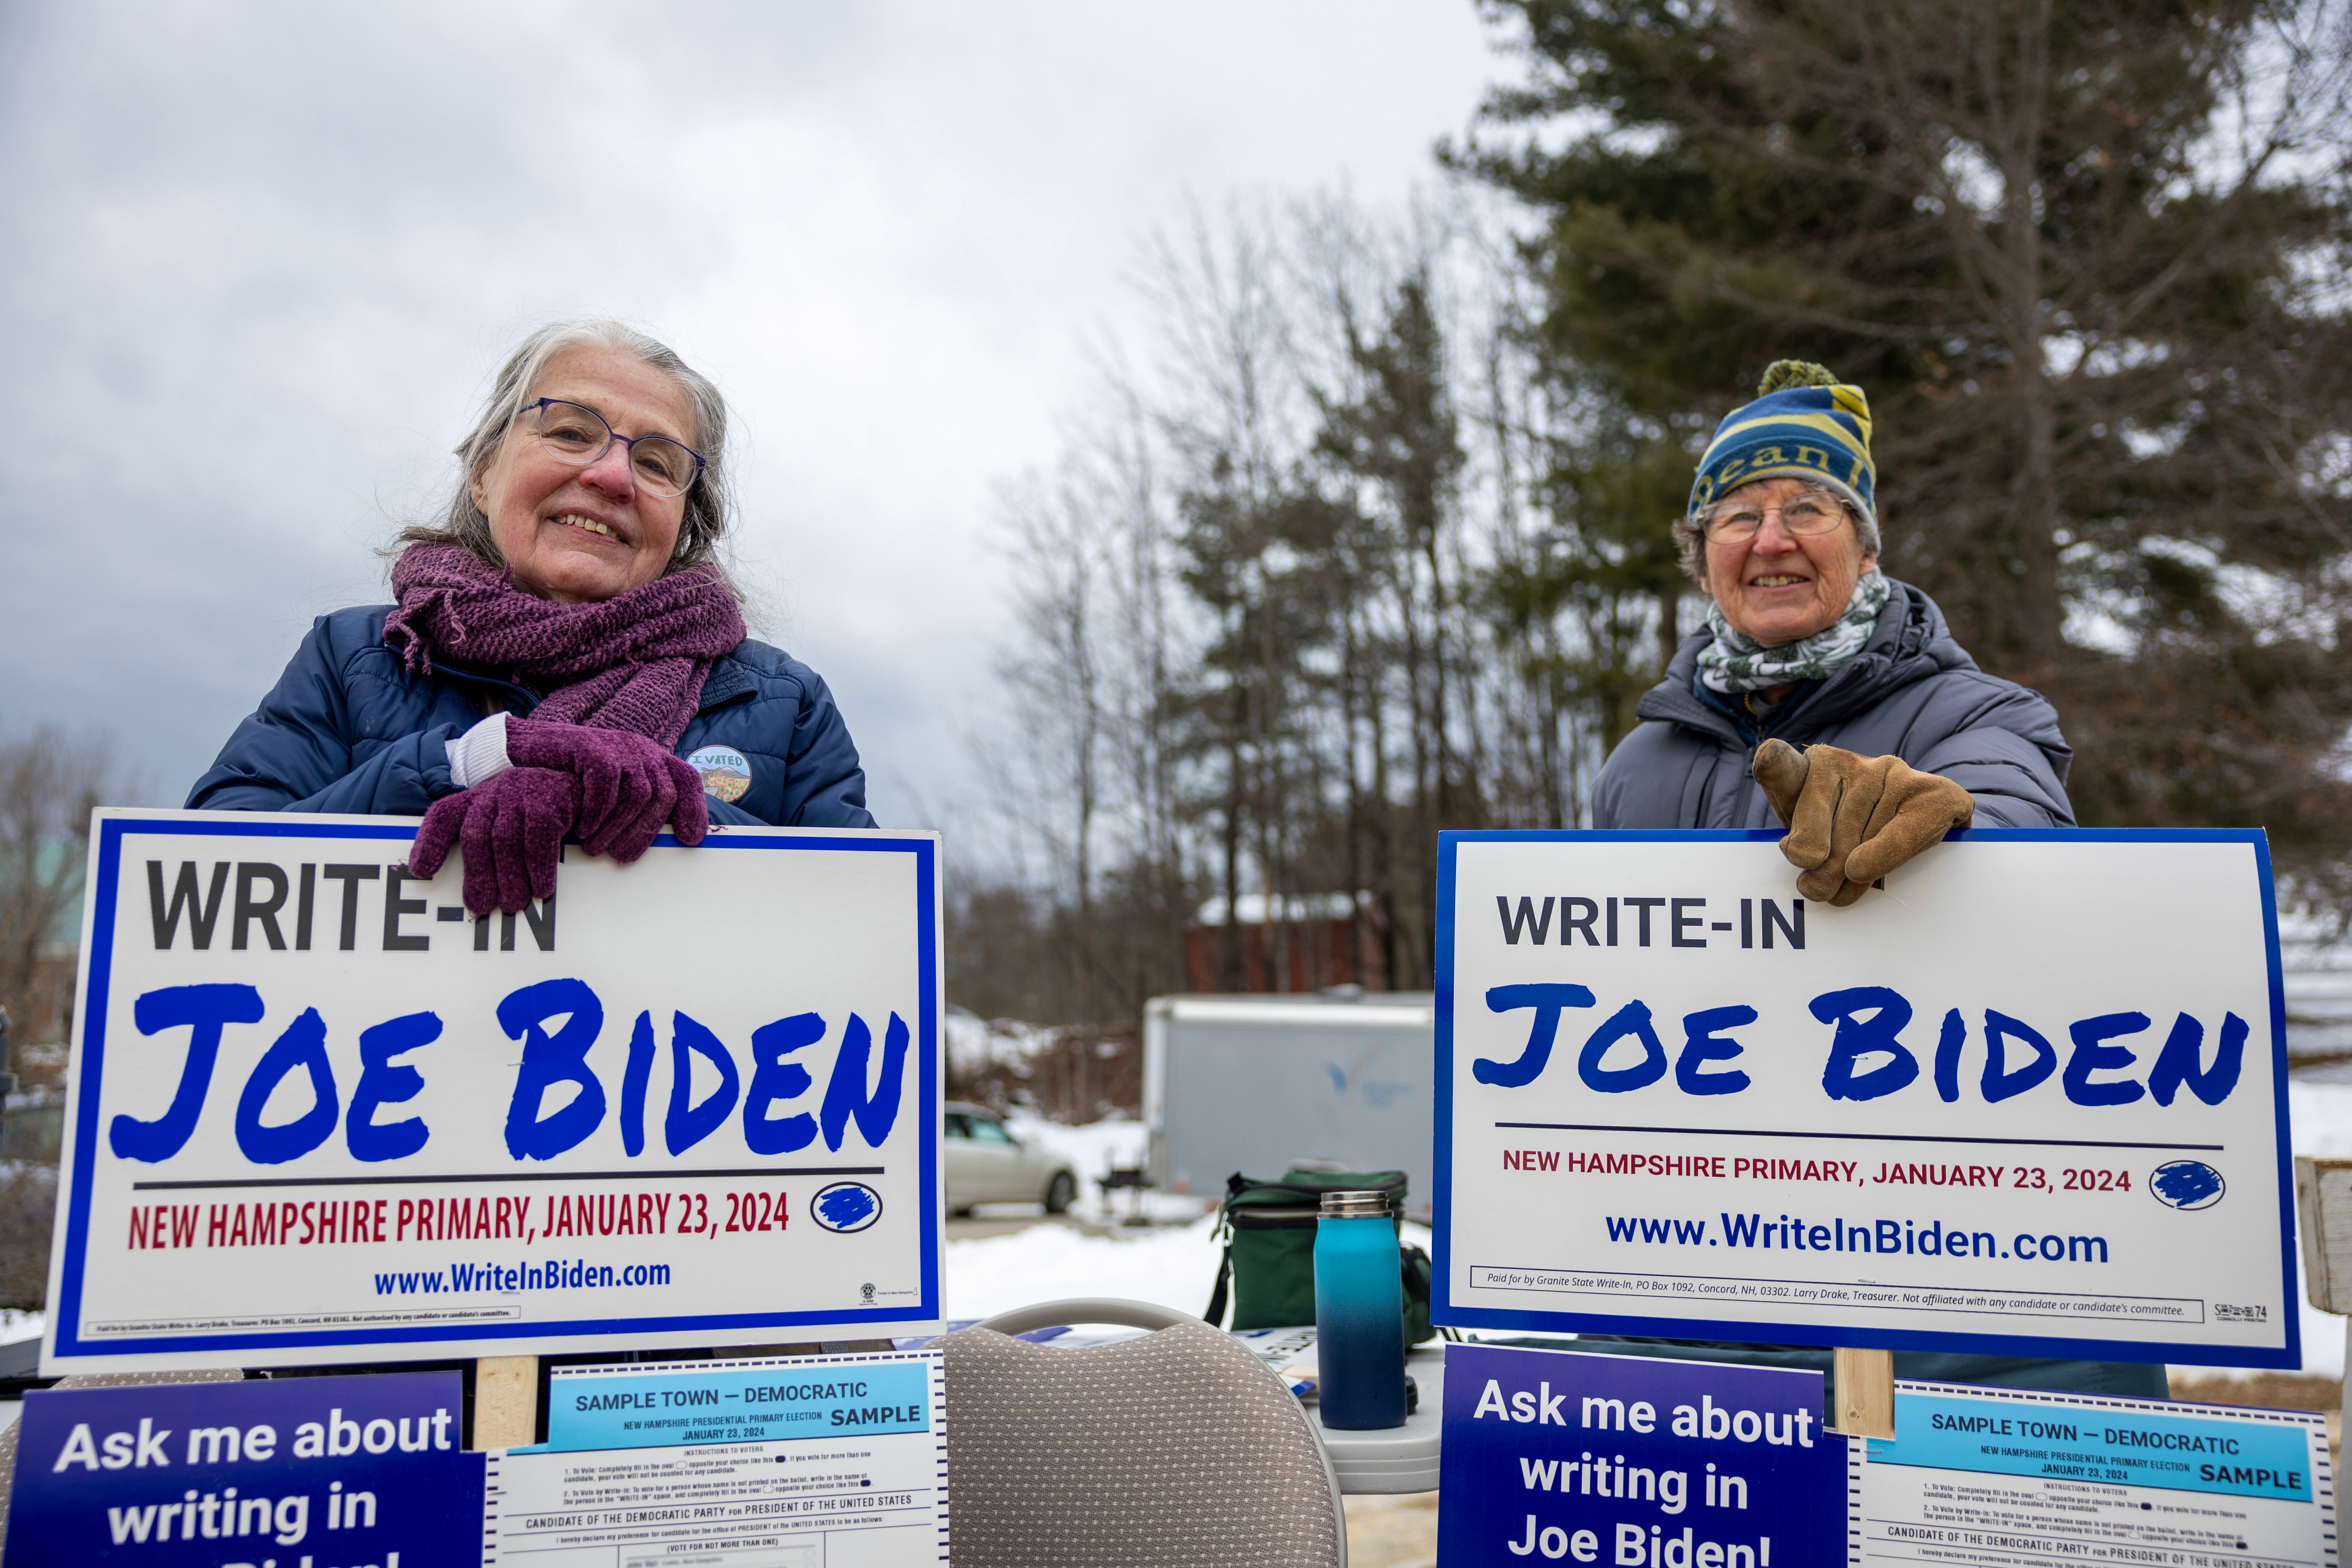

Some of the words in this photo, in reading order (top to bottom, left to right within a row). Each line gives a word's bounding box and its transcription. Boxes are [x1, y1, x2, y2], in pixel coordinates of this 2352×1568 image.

[692, 755, 702, 764] I
[1496, 896, 1806, 950] WRITE-IN
[1472, 984, 1758, 1095] JOE
[1808, 986, 2250, 1107] BIDEN
[109, 983, 443, 1164] JOE
[496, 978, 909, 1161] BIDEN
[1504, 1150, 1560, 1171] NEW
[1569, 1152, 1725, 1177] HAMPSHIRE
[1735, 1158, 1863, 1187] PRIMARY,
[1873, 1163, 2004, 1187] JANUARY
[2013, 1167, 2053, 1193] 23,
[2063, 1169, 2131, 1191] 2024
[129, 1205, 199, 1249] NEW
[208, 1200, 387, 1247] HAMPSHIRE
[397, 1197, 535, 1245] PRIMARY,
[543, 1193, 671, 1237] JANUARY
[678, 1194, 717, 1240] 23,
[726, 1192, 788, 1232] 2024
[1606, 1213, 2107, 1263] www.WriteInBiden.com
[375, 1259, 670, 1294] www.WriteInBiden.com
[1487, 1273, 1506, 1282] Paid
[1508, 1274, 1522, 1285] for
[1524, 1275, 1535, 1286] by
[1537, 1276, 1569, 1285] Granite
[1572, 1278, 1594, 1287] State
[1597, 1279, 1633, 1290] Write-In,
[1636, 1281, 1649, 1290] PO
[1652, 1281, 1668, 1290] Box
[1671, 1282, 1695, 1293] 1092,
[1699, 1283, 1739, 1295] Concord,
[1741, 1285, 1758, 1296] NH,
[1760, 1287, 1791, 1296] 03302.
[1794, 1288, 1818, 1300] Larry
[1820, 1289, 1850, 1300] Drake,
[1853, 1291, 1900, 1301] Treasurer.
[1903, 1293, 1920, 1303] Not
[1922, 1294, 1964, 1306] affiliated
[1966, 1296, 1986, 1306] with
[1989, 1299, 2007, 1309] any
[2009, 1299, 2057, 1309] candidate
[2073, 1302, 2127, 1312] candidate's
[2131, 1305, 2185, 1315] committee.
[576, 1393, 655, 1411] SAMPLE
[661, 1390, 718, 1406] TOWN
[746, 1382, 867, 1403] DEMOCRATIC
[831, 1406, 920, 1426] SAMPLE
[1474, 1379, 1566, 1426] Ask
[1582, 1397, 1656, 1433] me
[1672, 1395, 1813, 1447] about
[54, 1418, 172, 1472] Ask
[187, 1425, 276, 1464] me
[293, 1408, 452, 1457] about
[624, 1421, 641, 1430] NEW
[644, 1419, 689, 1428] HAMPSHIRE
[693, 1416, 746, 1426] PRESIDENTIAL
[750, 1414, 784, 1423] PRIMARY
[787, 1412, 822, 1421] ELECTION
[683, 1429, 724, 1440] JANUARY
[728, 1429, 740, 1438] 23,
[744, 1428, 764, 1437] 2024
[1932, 1414, 2012, 1435] SAMPLE
[2017, 1421, 2077, 1441] TOWN
[2105, 1428, 2239, 1455] DEMOCRATIC
[1982, 1446, 1998, 1454] NEW
[2002, 1448, 2048, 1459] HAMPSHIRE
[2052, 1452, 2108, 1464] PRESIDENTIAL
[2111, 1457, 2148, 1468] PRIMARY
[2151, 1461, 2190, 1472] ELECTION
[2042, 1464, 2084, 1476] JANUARY
[2088, 1468, 2102, 1479] 23,
[2106, 1469, 2127, 1480] 2024
[2201, 1465, 2301, 1490] SAMPLE
[1520, 1452, 1687, 1514] writing
[1706, 1463, 1747, 1509] in
[2044, 1483, 2090, 1492] INSTRUCTIONS
[108, 1487, 309, 1546] writing
[328, 1481, 376, 1529] in
[526, 1516, 582, 1528] CANDIDATE
[588, 1515, 599, 1524] OF
[604, 1514, 621, 1523] THE
[626, 1510, 689, 1522] DEMOCRATIC
[695, 1507, 725, 1517] PARTY
[746, 1503, 798, 1514] PRESIDENT
[803, 1501, 814, 1510] OF
[818, 1500, 835, 1509] THE
[840, 1498, 873, 1508] UNITED
[878, 1495, 911, 1505] STATES
[668, 1544, 686, 1553] (VOTE
[1508, 1515, 1598, 1562] Joe
[1615, 1523, 1769, 1568] Biden!
[1889, 1527, 1943, 1540] CANDIDATE
[1948, 1532, 1959, 1541] OF
[1964, 1534, 1982, 1544] THE
[1987, 1536, 2051, 1550] DEMOCRATIC
[2057, 1543, 2088, 1554] PARTY
[2111, 1548, 2167, 1562] PRESIDENT
[2173, 1554, 2184, 1564] OF
[2190, 1556, 2208, 1566] THE
[2214, 1555, 2253, 1568] UNITED
